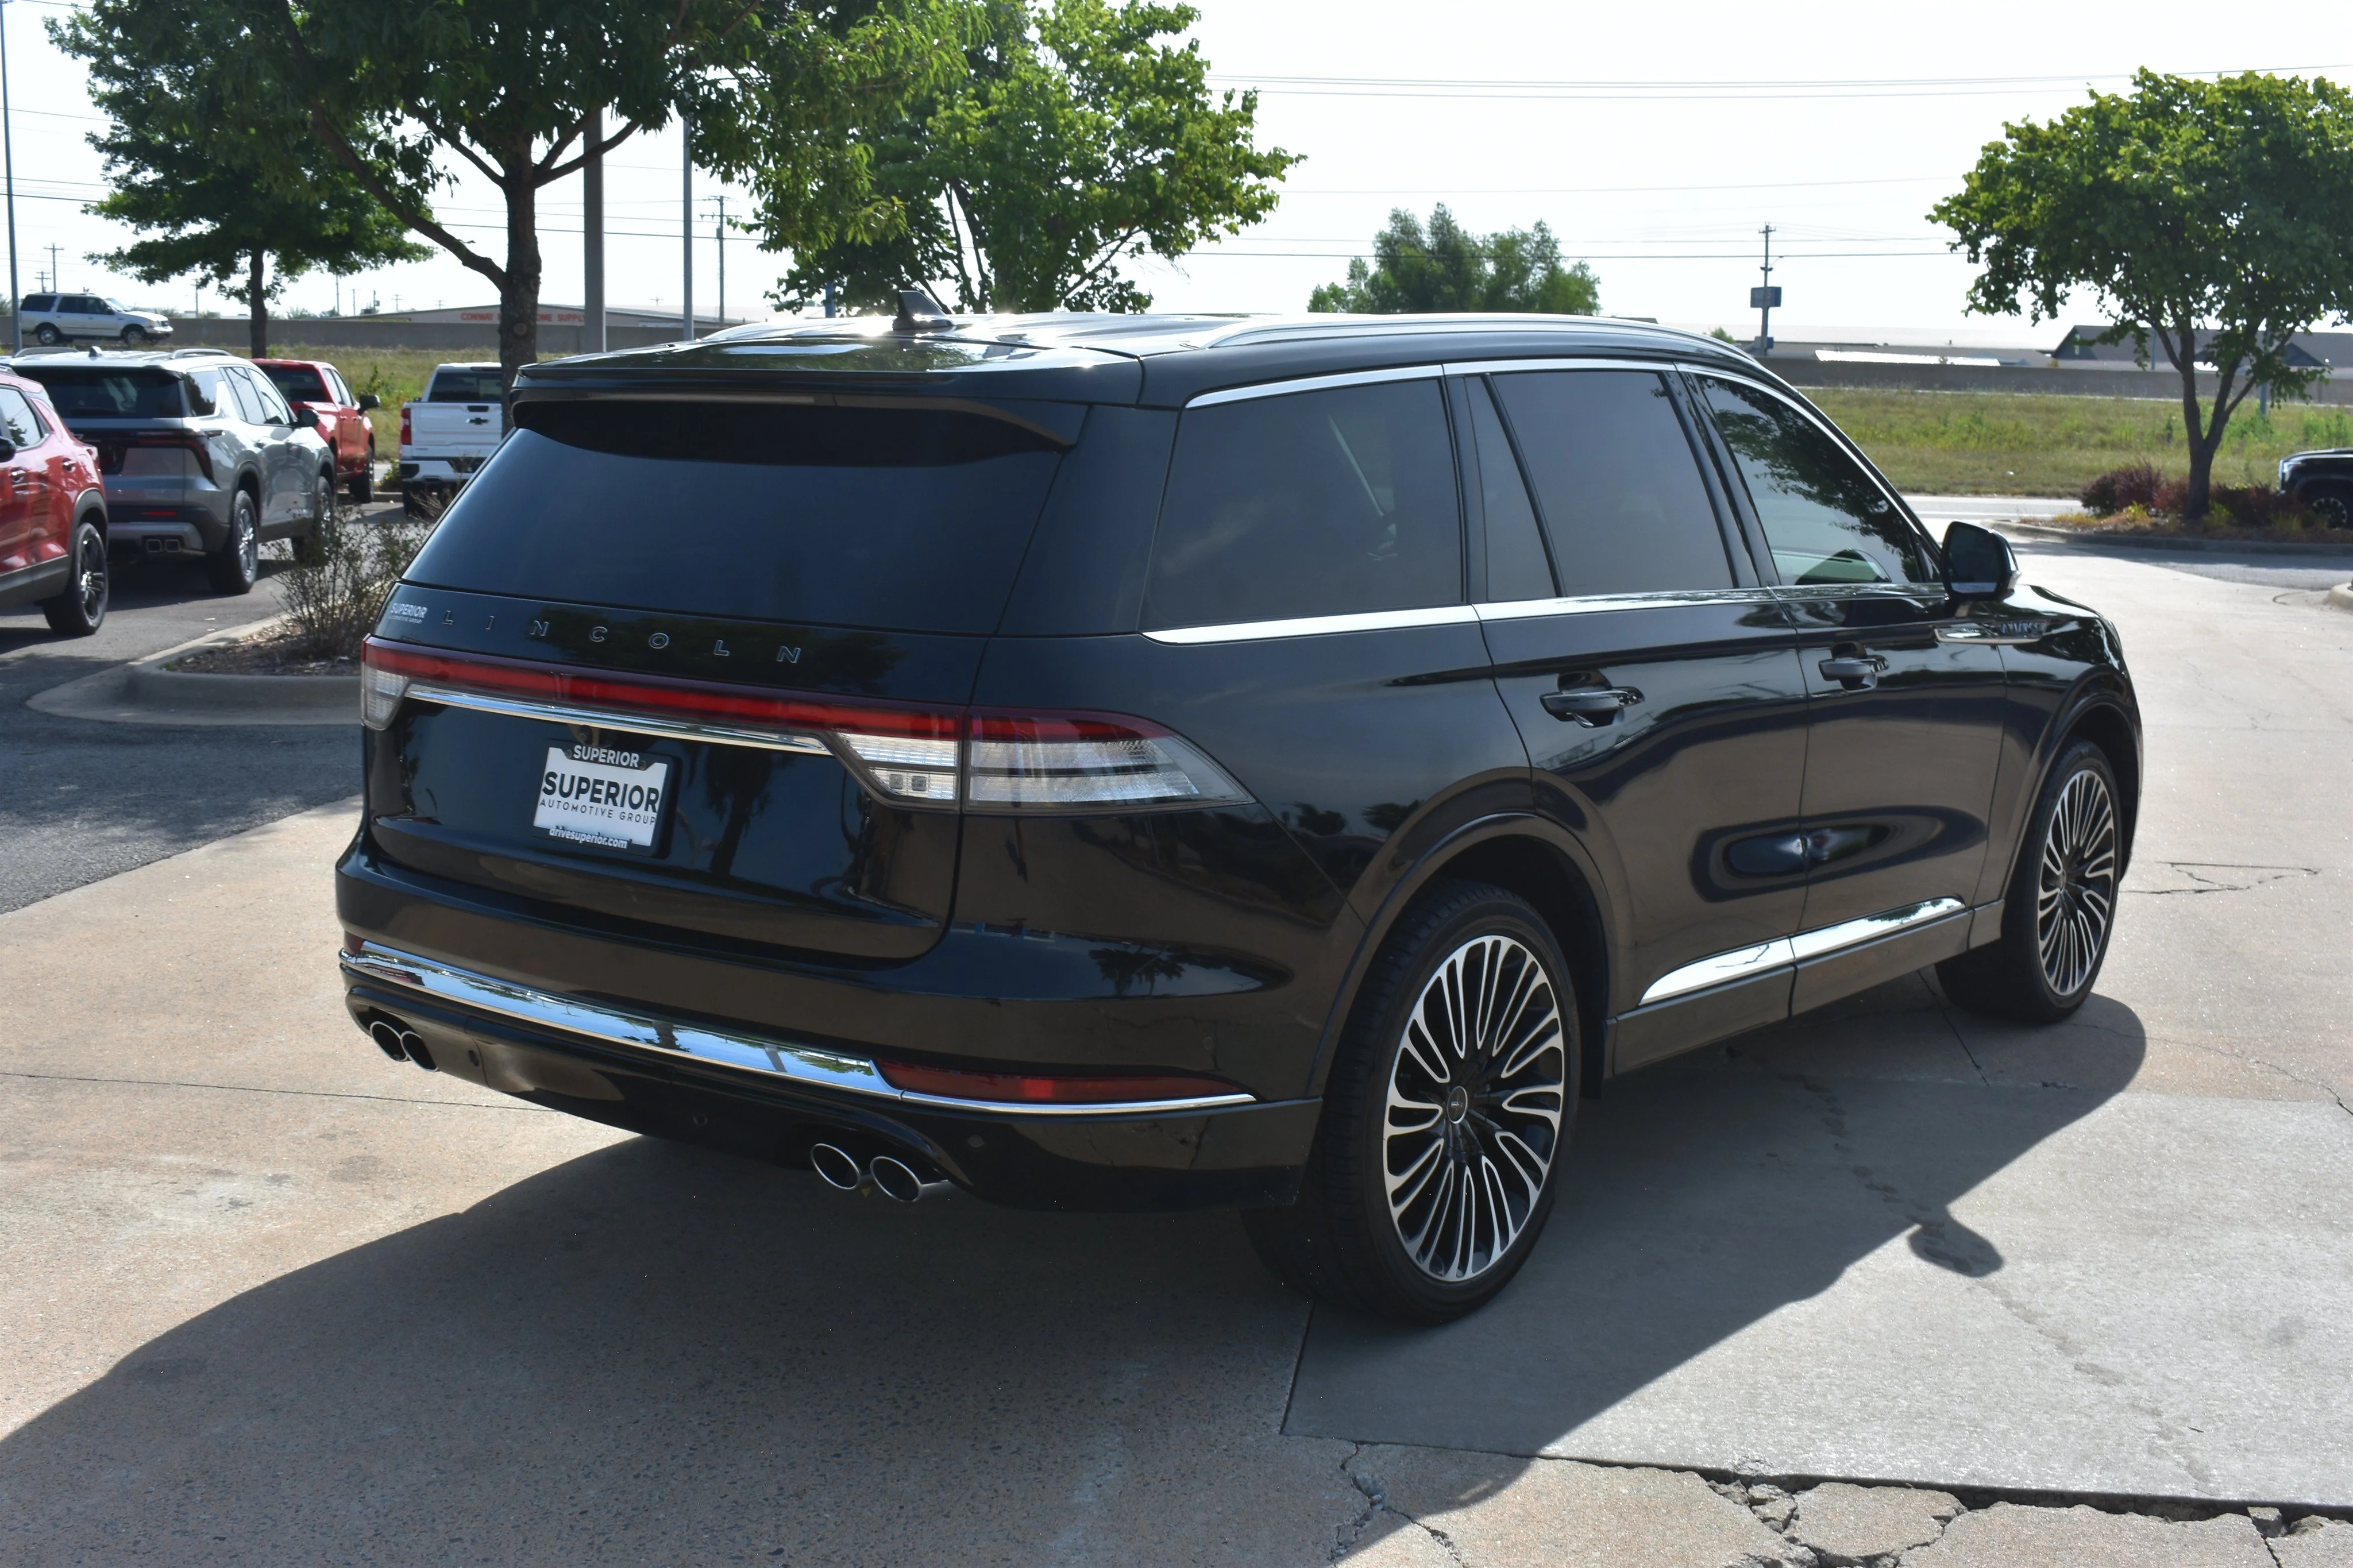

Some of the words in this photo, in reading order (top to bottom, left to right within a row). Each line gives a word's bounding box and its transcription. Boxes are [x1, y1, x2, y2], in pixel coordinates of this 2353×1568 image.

[391, 603, 427, 619] SUPERIOR
[442, 610, 801, 664] LINCOLN
[573, 744, 639, 768] SUPERIOR
[542, 771, 659, 813] SUPERIOR
[539, 798, 614, 819] AUTOMOTIVE
[619, 812, 656, 825] GROUP
[549, 825, 628, 849] drivesuperior.com
